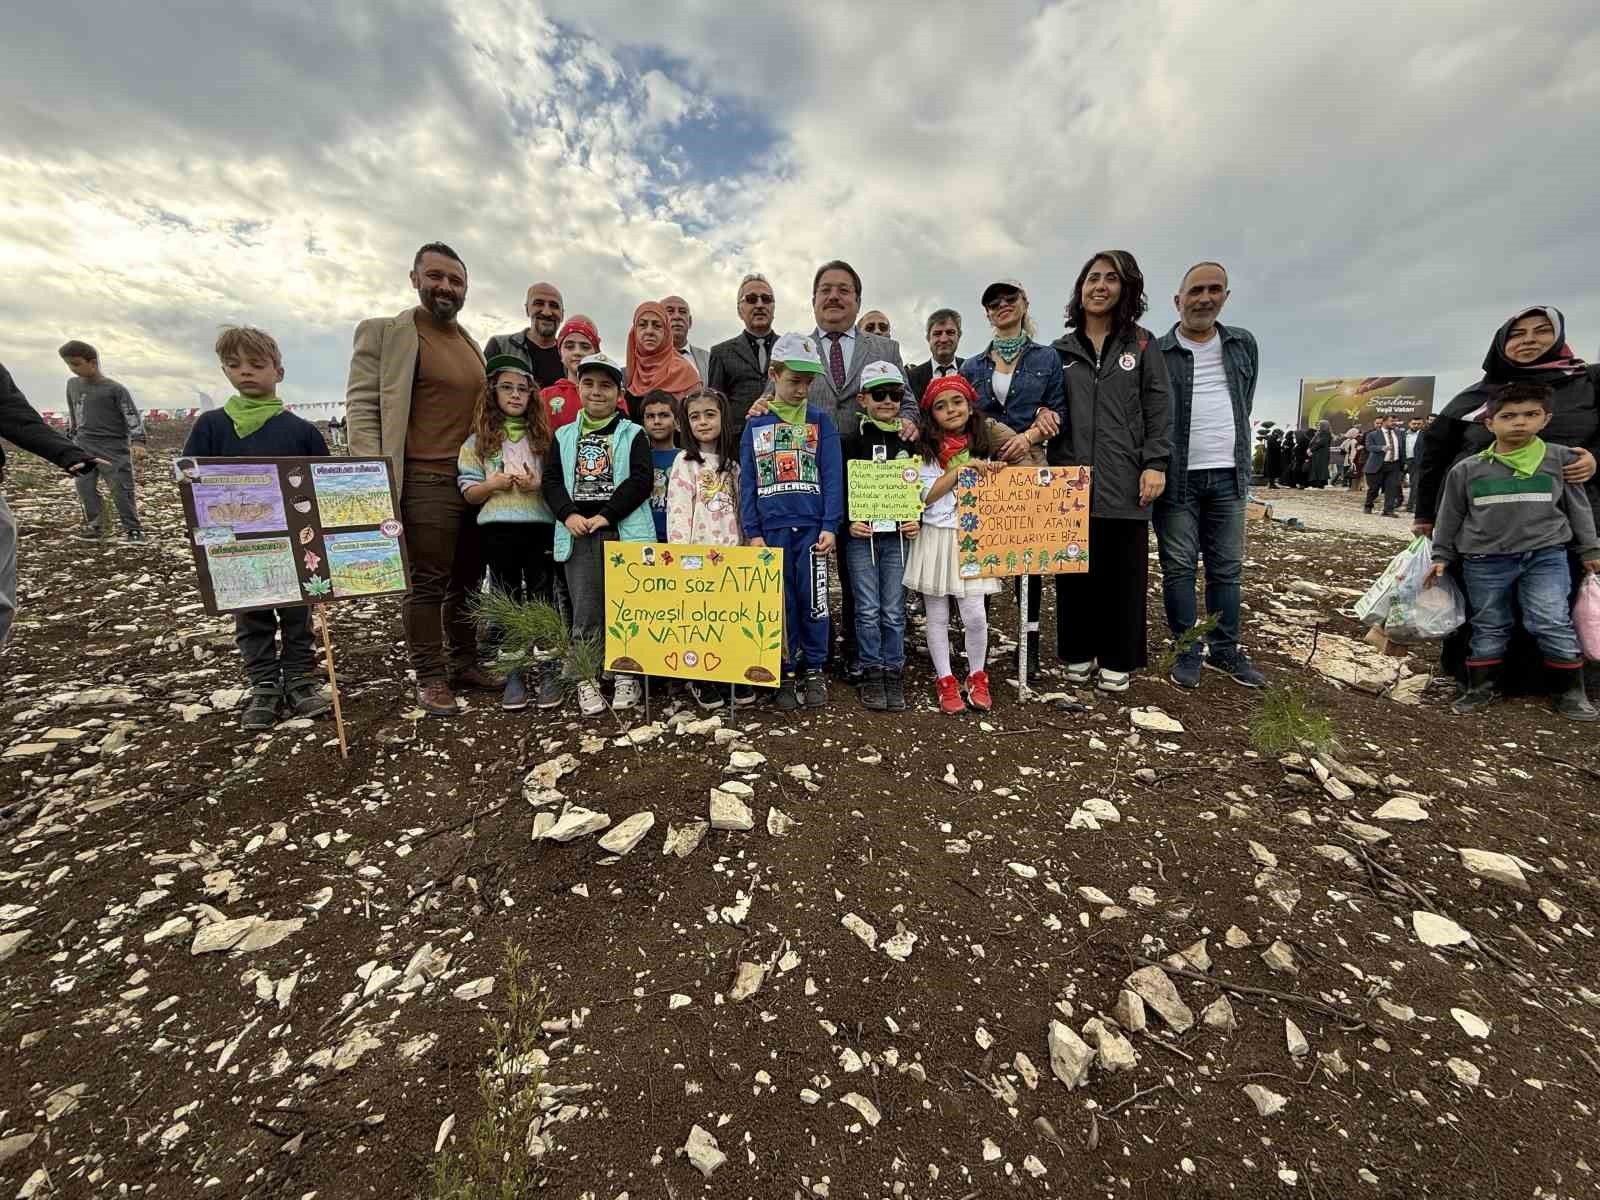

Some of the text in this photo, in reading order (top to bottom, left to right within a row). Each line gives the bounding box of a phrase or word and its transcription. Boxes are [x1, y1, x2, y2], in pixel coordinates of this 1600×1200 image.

[757, 482, 821, 496] MINECRAFT
[978, 503, 1027, 516] KOCAMAN
[624, 562, 781, 594] Sana söz ATAM
[690, 600, 752, 623] olacak
[756, 599, 779, 624] bu
[647, 623, 725, 647] VATAN
